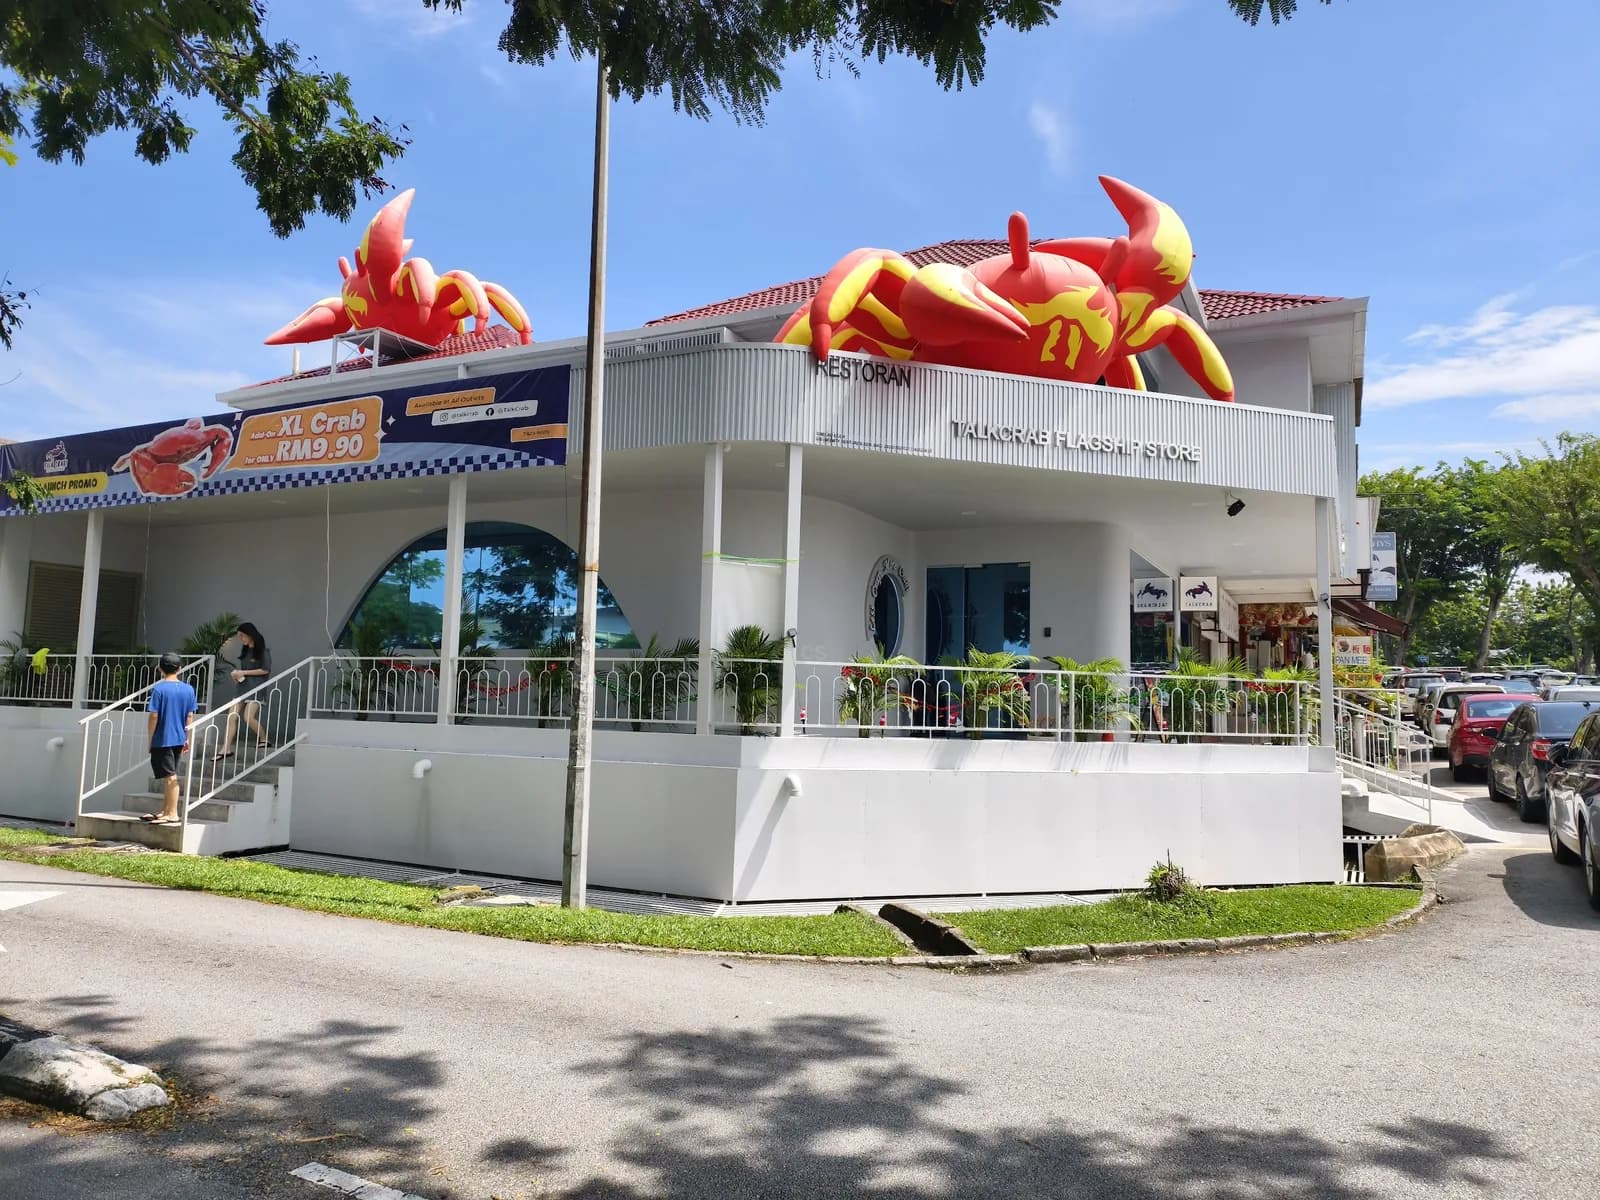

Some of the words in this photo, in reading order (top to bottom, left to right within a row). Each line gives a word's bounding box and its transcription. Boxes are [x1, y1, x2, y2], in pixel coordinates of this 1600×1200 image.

[815, 356, 911, 388] RESTORAN
[277, 414, 304, 437] XL
[310, 408, 366, 435] Crab
[276, 433, 364, 463] RM9.90
[952, 419, 1050, 447] TALKCRAB
[1055, 430, 1142, 457] FLAGSHIP
[1145, 442, 1201, 463] STORE
[68, 478, 98, 490] PROMO
[1335, 656, 1350, 664] PAN
[1351, 656, 1368, 665] MEE
